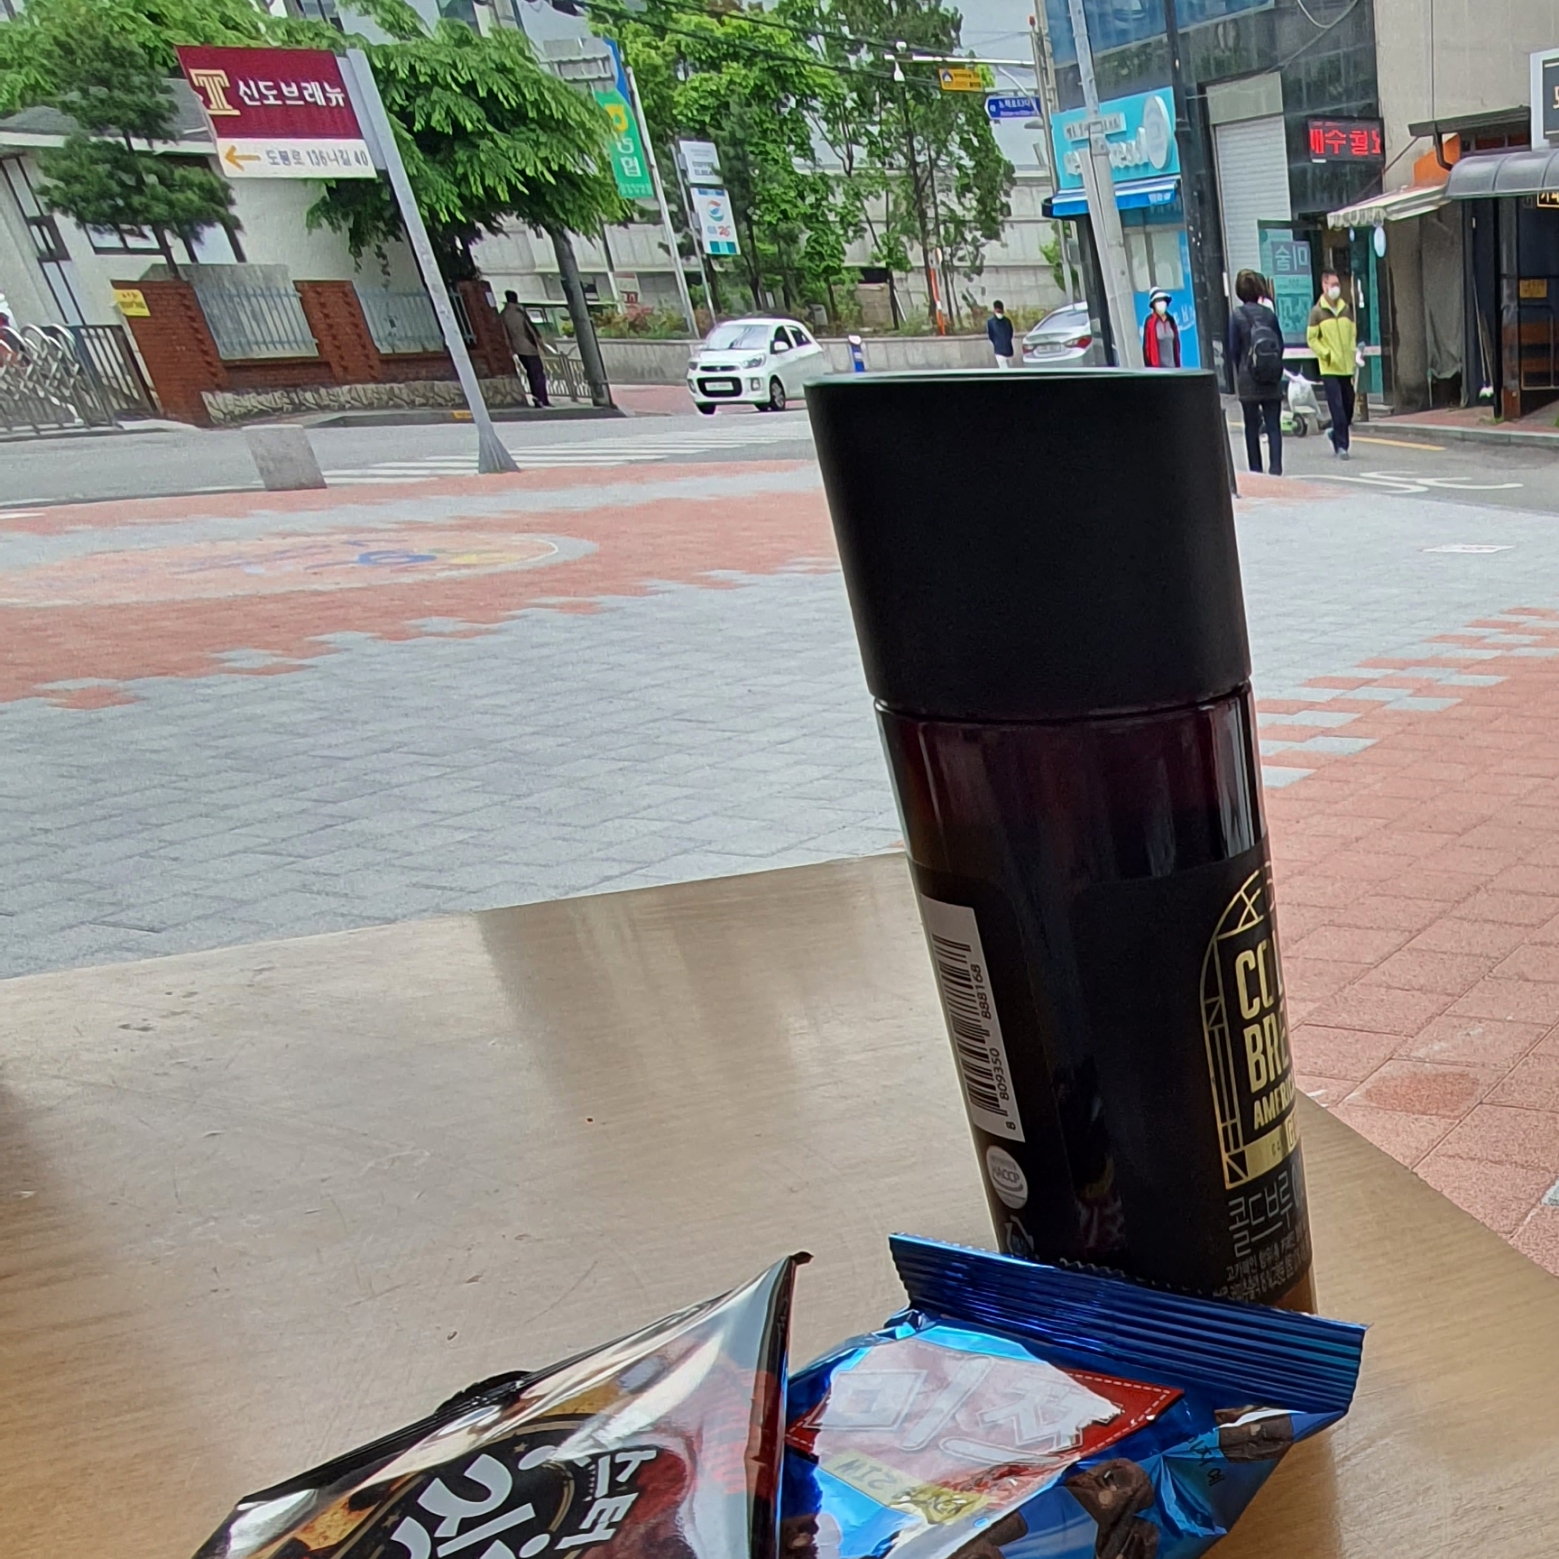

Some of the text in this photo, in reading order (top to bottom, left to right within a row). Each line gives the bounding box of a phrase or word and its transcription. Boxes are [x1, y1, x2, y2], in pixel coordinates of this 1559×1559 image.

[238, 79, 346, 107] 신도브래뉴
[970, 964, 992, 1021] 888168
[989, 1047, 1011, 1102] 809350
[1005, 1119, 1017, 1131] 8
[553, 1450, 657, 1551] 스터
